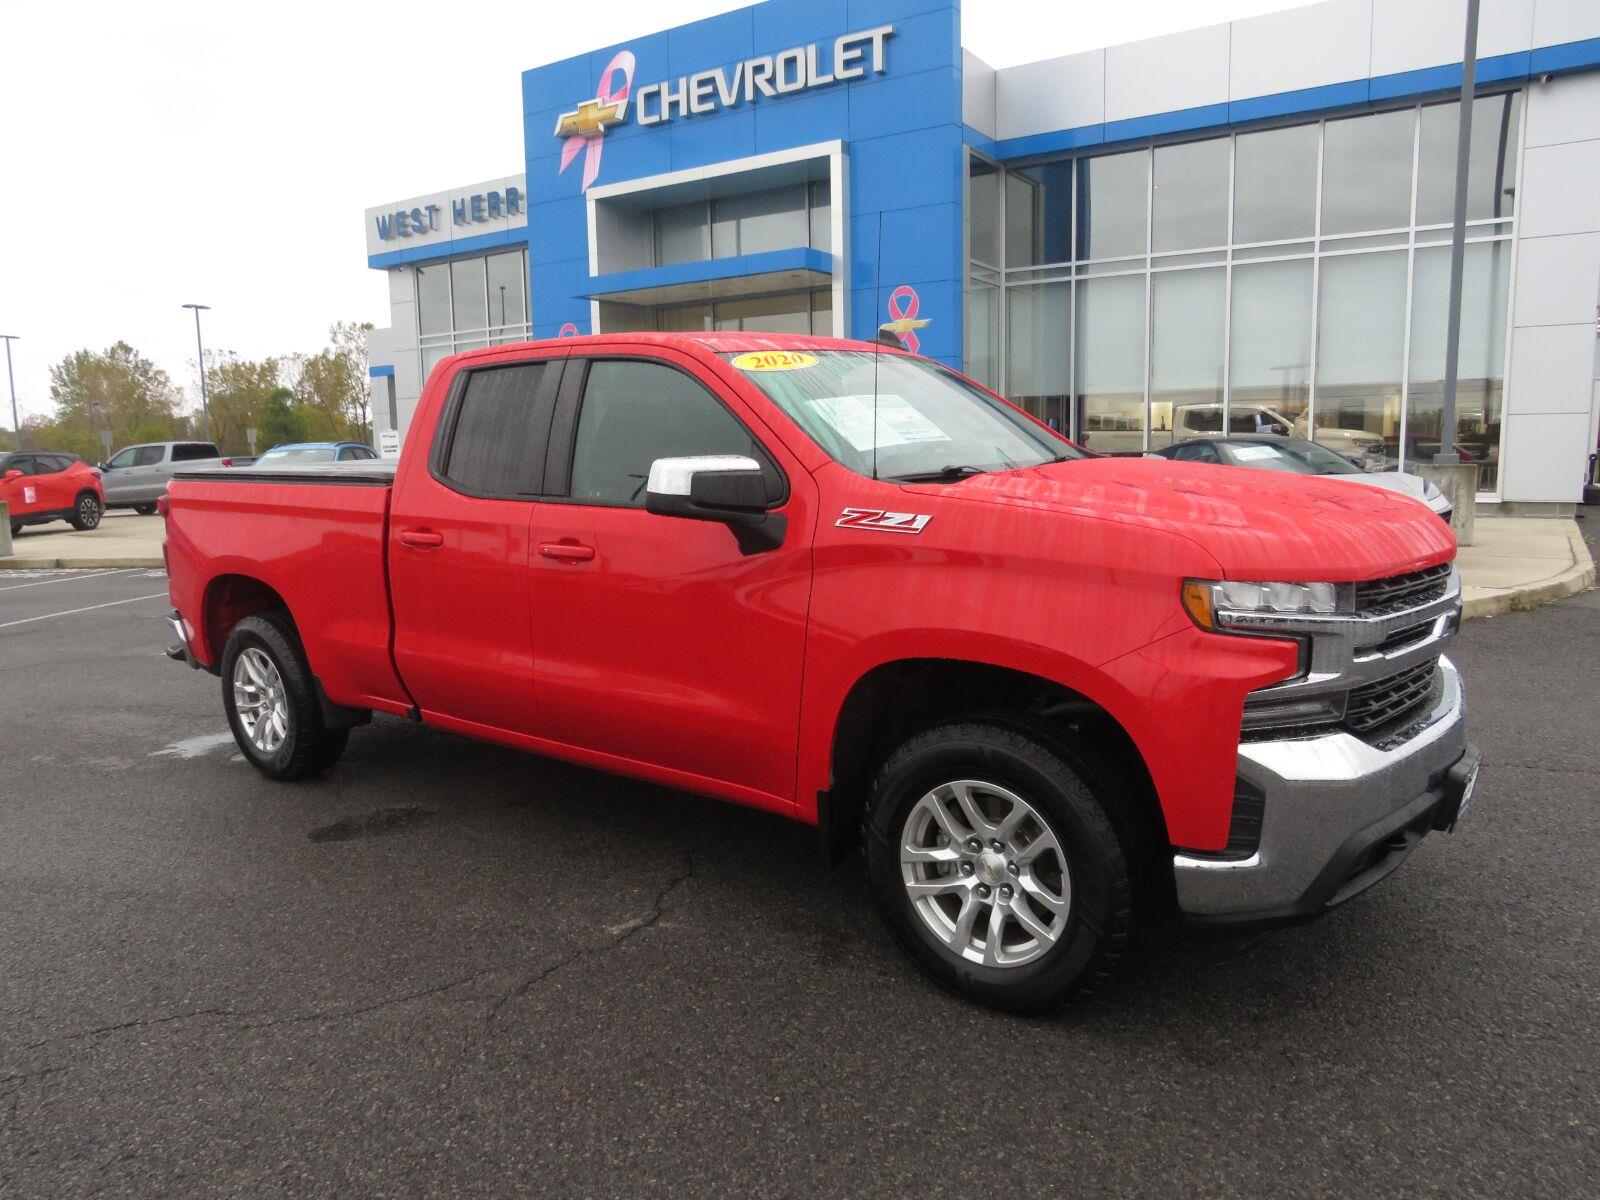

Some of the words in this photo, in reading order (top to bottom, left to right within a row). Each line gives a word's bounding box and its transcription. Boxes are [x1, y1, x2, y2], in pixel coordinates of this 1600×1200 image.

[636, 24, 895, 126] CHEVROLET
[375, 204, 440, 241] WEST
[452, 187, 523, 227] HERR
[750, 352, 804, 369] 2020
[834, 507, 933, 534] Z71
